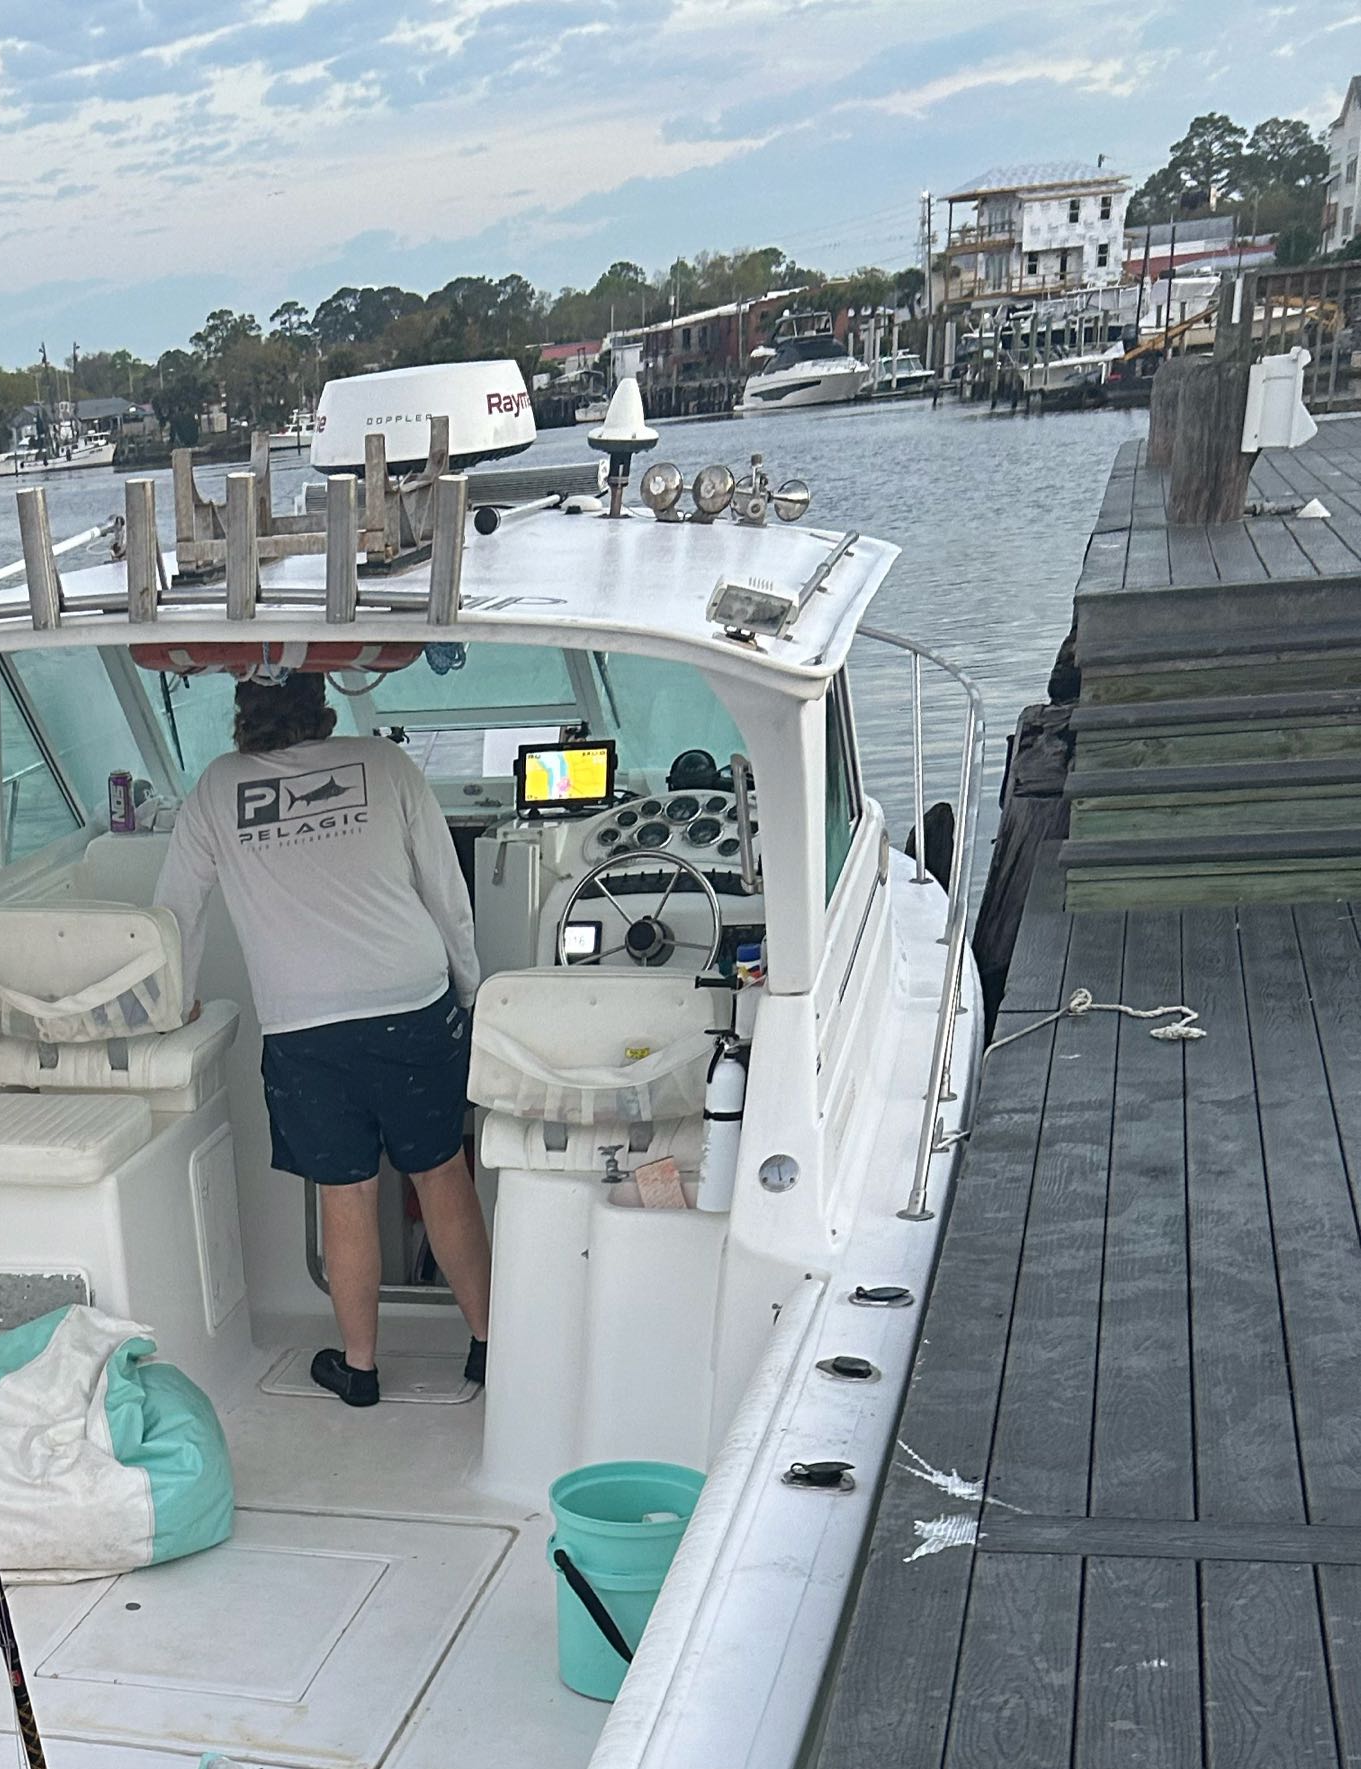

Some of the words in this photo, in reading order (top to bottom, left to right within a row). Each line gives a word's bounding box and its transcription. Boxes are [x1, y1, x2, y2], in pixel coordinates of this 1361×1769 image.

[366, 413, 433, 426] DOPPLER
[111, 783, 126, 823] NOS
[238, 811, 368, 845] PELAGIC
